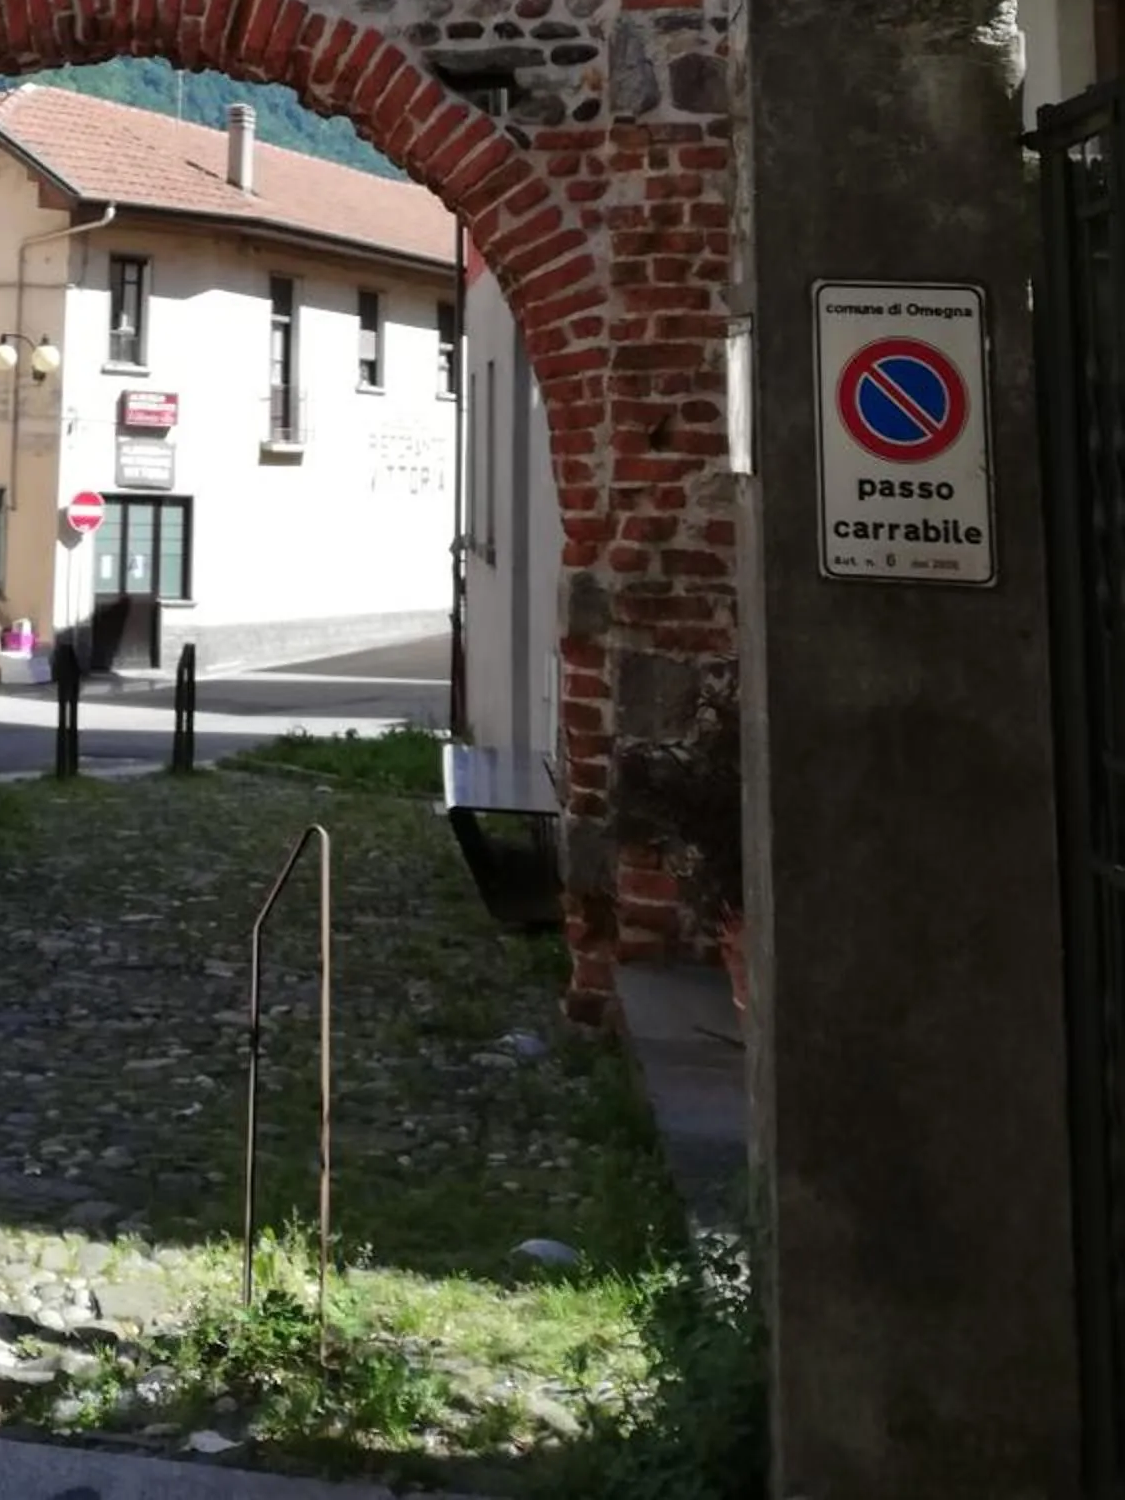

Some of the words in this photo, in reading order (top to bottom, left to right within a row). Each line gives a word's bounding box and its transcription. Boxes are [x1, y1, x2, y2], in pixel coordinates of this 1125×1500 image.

[826, 304, 884, 315] comune
[888, 304, 902, 315] di
[906, 303, 973, 319] Omegna
[858, 478, 954, 500] passo
[834, 518, 982, 544] carrabile
